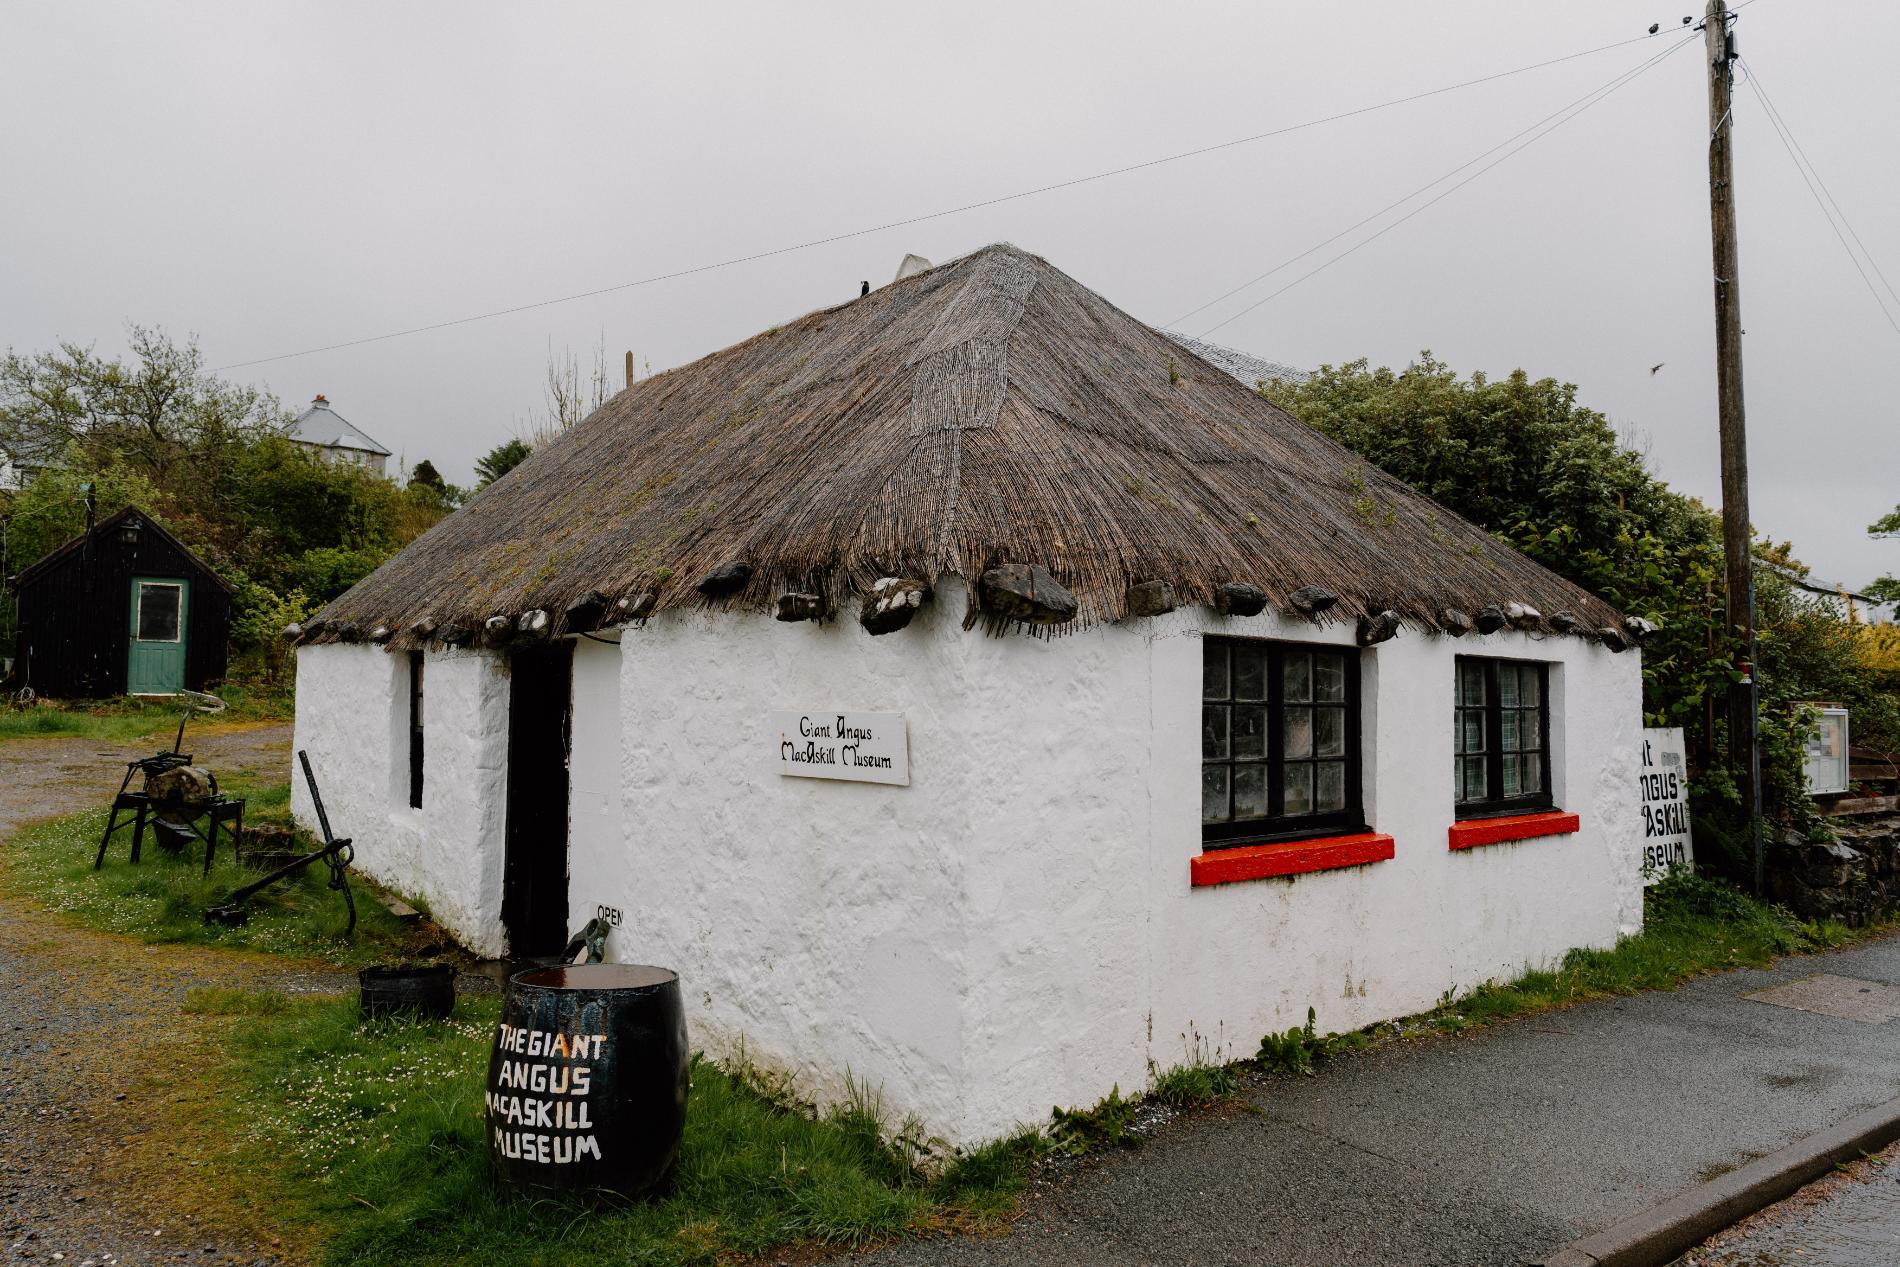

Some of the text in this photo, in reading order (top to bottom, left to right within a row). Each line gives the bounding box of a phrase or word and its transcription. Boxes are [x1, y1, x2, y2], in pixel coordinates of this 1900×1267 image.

[799, 715, 872, 748] Giant Angus
[781, 741, 892, 769] MacAskill Museum
[597, 904, 624, 927] OPEN
[499, 1060, 591, 1096] ANGUS
[484, 1089, 593, 1129] MACASKILL
[494, 1125, 602, 1164] MUSEUM
